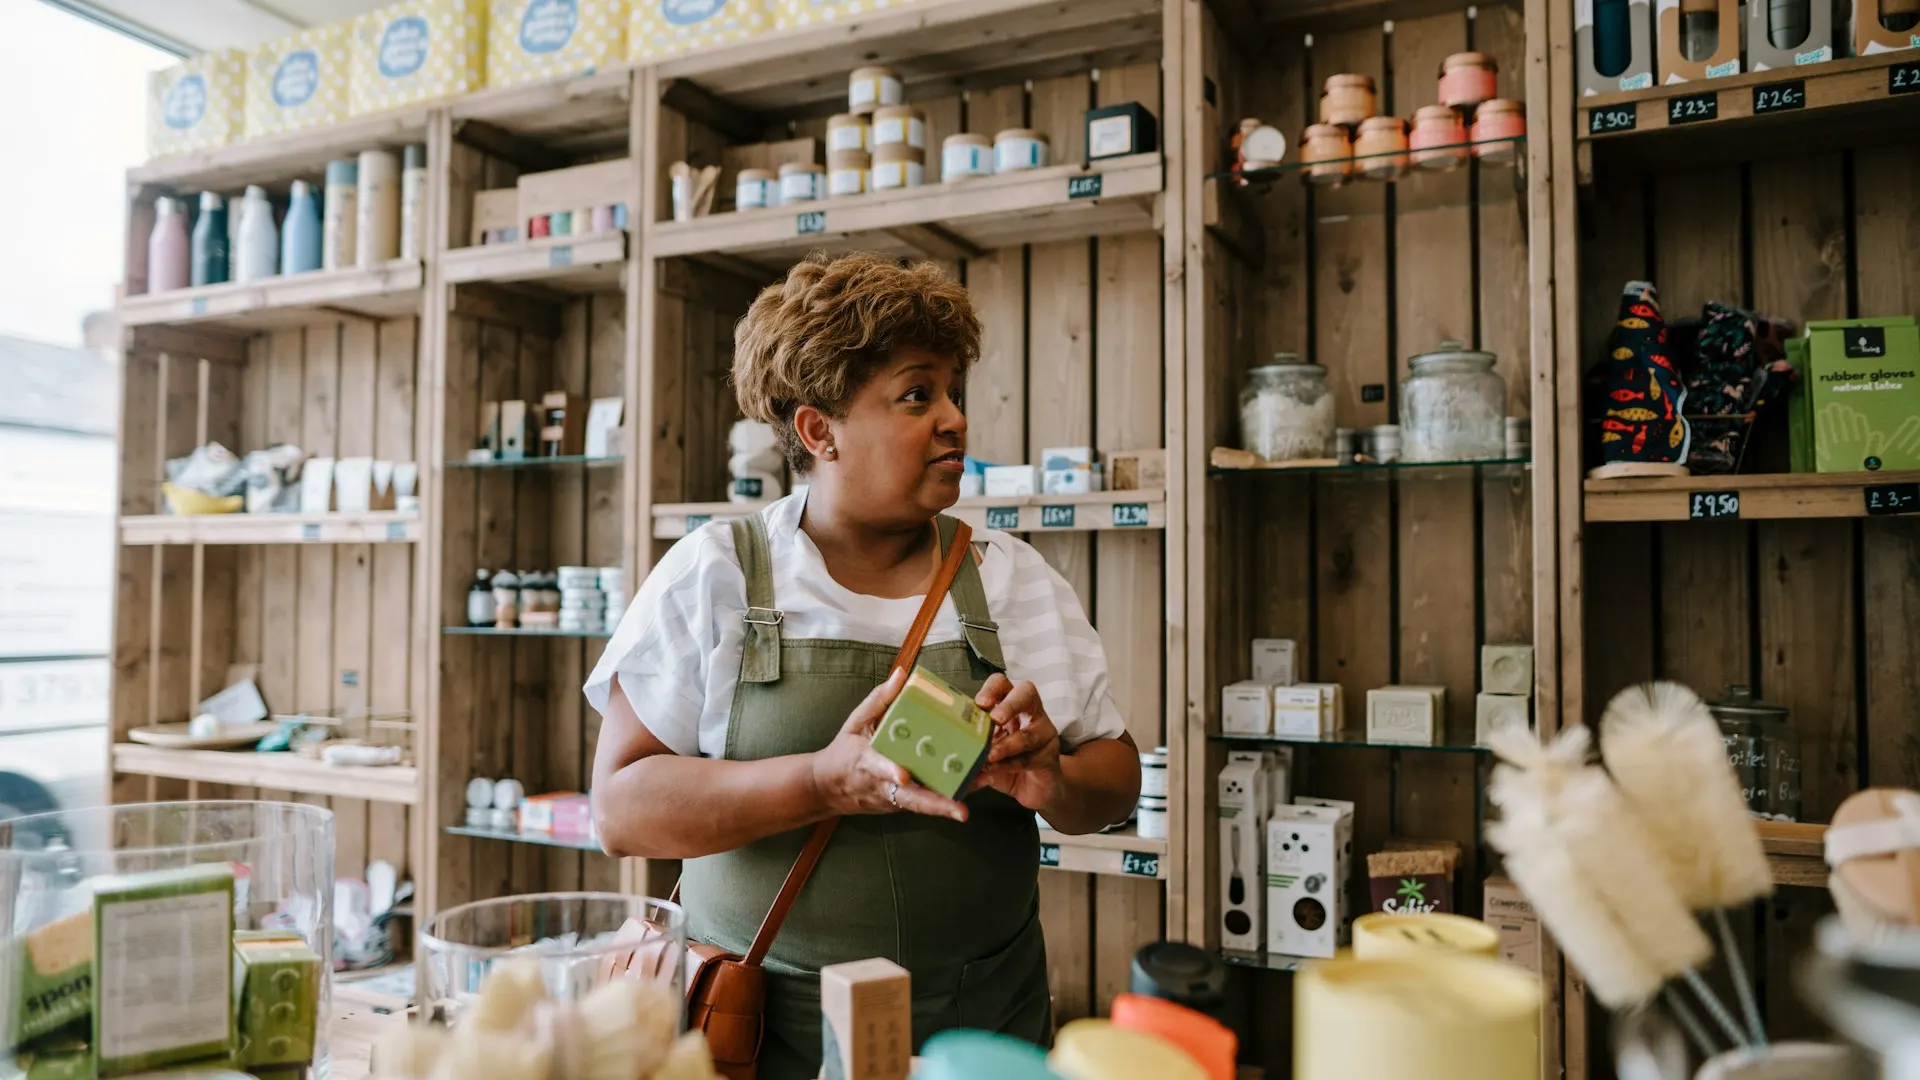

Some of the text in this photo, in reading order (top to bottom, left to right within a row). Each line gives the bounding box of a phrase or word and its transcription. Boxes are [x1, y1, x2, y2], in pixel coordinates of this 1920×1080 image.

[1820, 369, 1915, 382] rubber gloves
[1832, 381, 1902, 392] natural latex
[1692, 494, 1739, 517] £9.50
[26, 975, 92, 1012] spon
